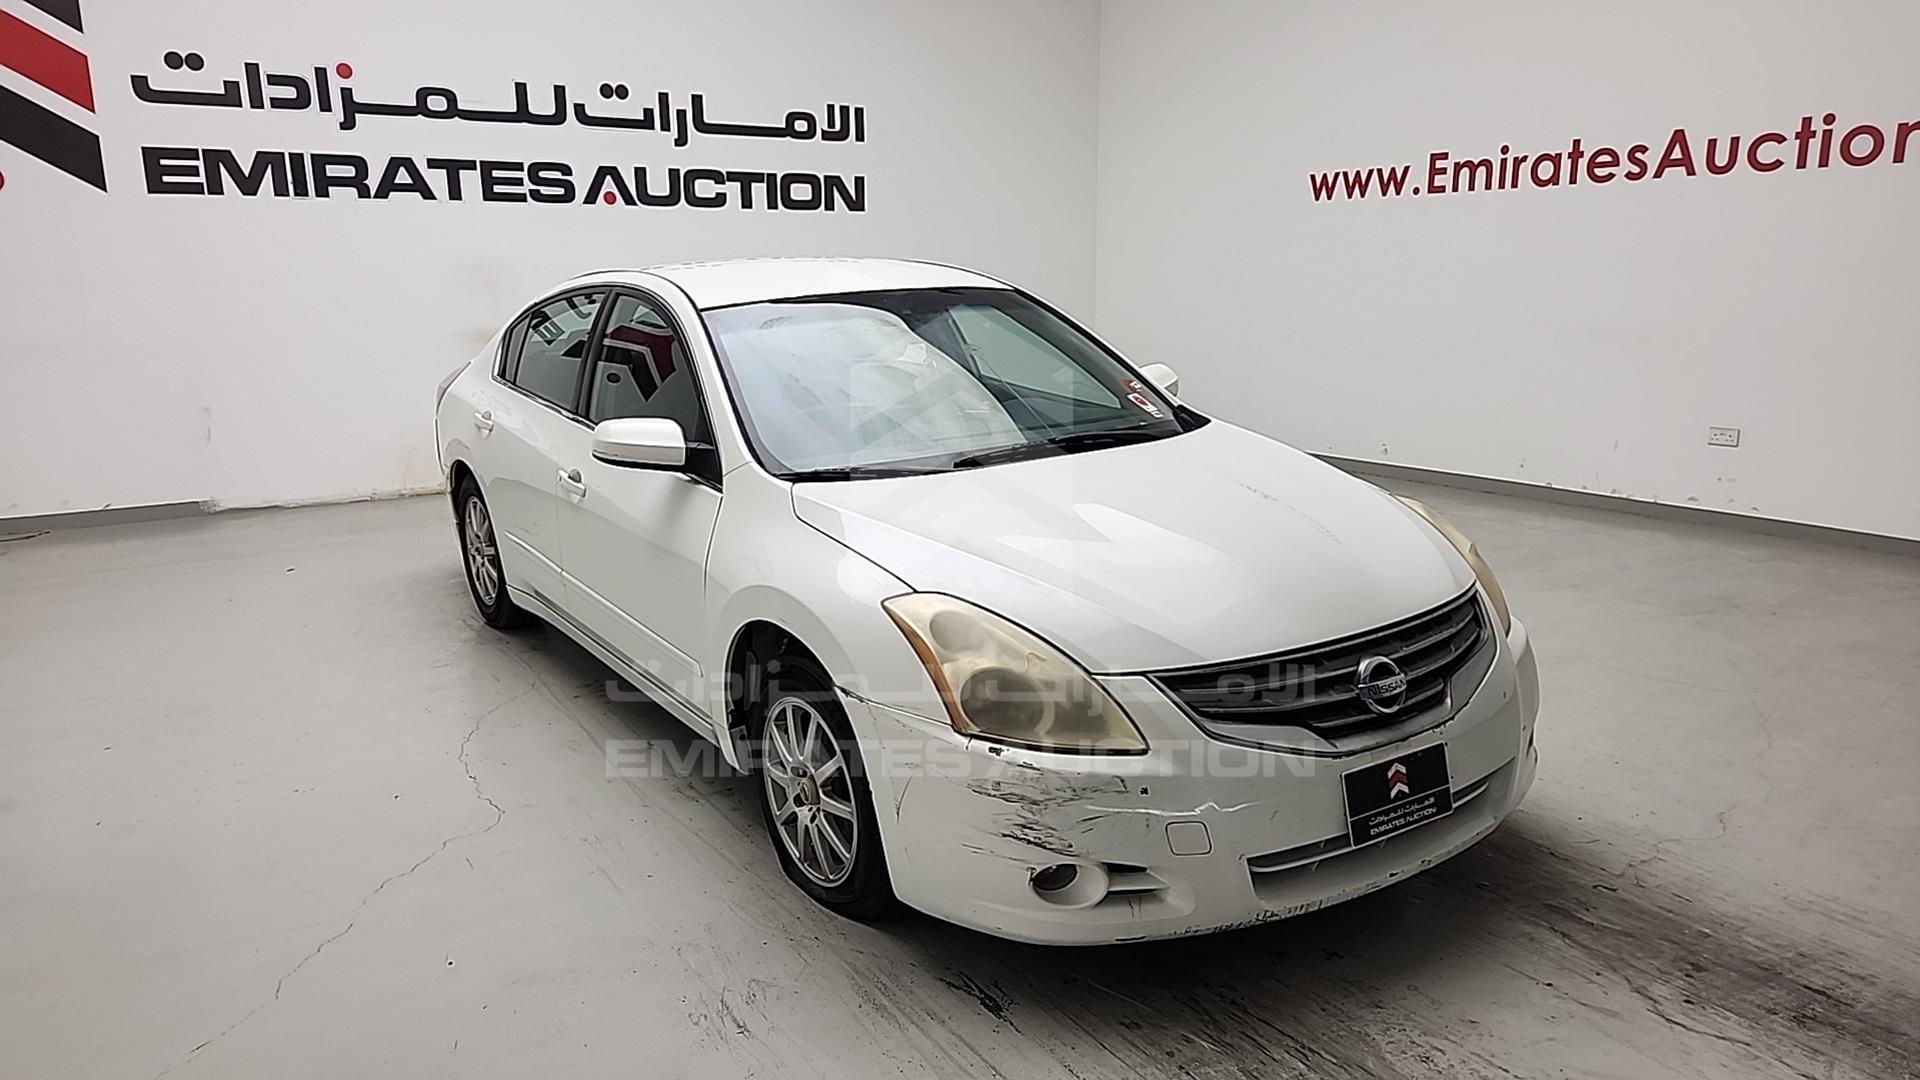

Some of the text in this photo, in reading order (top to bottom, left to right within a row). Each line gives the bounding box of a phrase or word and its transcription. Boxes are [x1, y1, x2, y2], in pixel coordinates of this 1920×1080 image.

[130, 51, 865, 147] الامارات للمزادات
[140, 146, 866, 212] EMIRATES AUCTION
[1367, 680, 1406, 697] NISSAN
[1370, 806, 1437, 836] EMIRATES AUCTION
